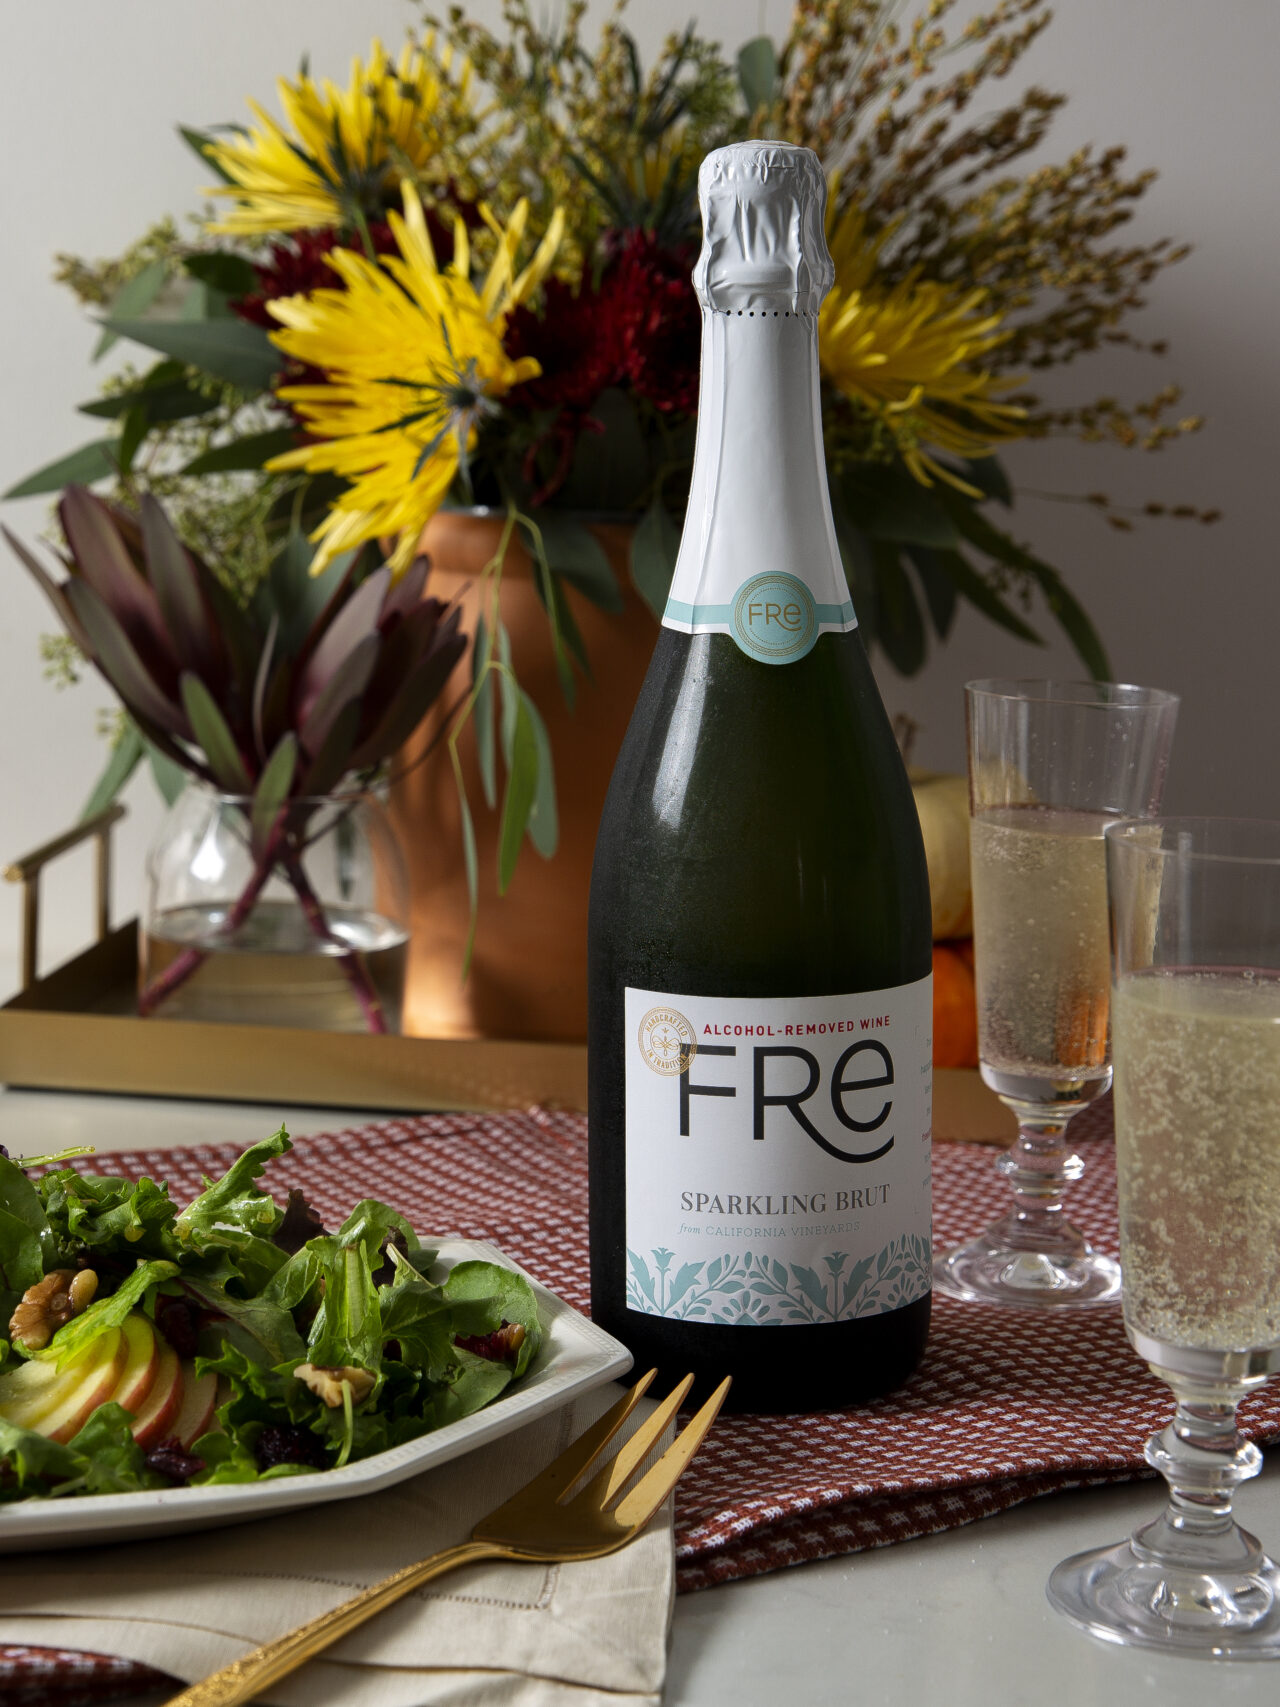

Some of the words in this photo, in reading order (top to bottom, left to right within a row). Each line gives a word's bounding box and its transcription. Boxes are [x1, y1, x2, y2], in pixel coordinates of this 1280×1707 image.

[644, 1013, 689, 1037] HANDCRAFTED
[703, 1020, 855, 1037] ALCOHOL-REMOVED
[860, 1015, 891, 1030] WINE
[652, 1052, 688, 1069] TRADITION
[680, 1191, 826, 1216] SPARKLING
[835, 1183, 891, 1212] BRUT
[677, 1223, 701, 1236] from
[705, 1225, 787, 1238] CALIFORNIA
[791, 1221, 861, 1237] VINEYARDS
